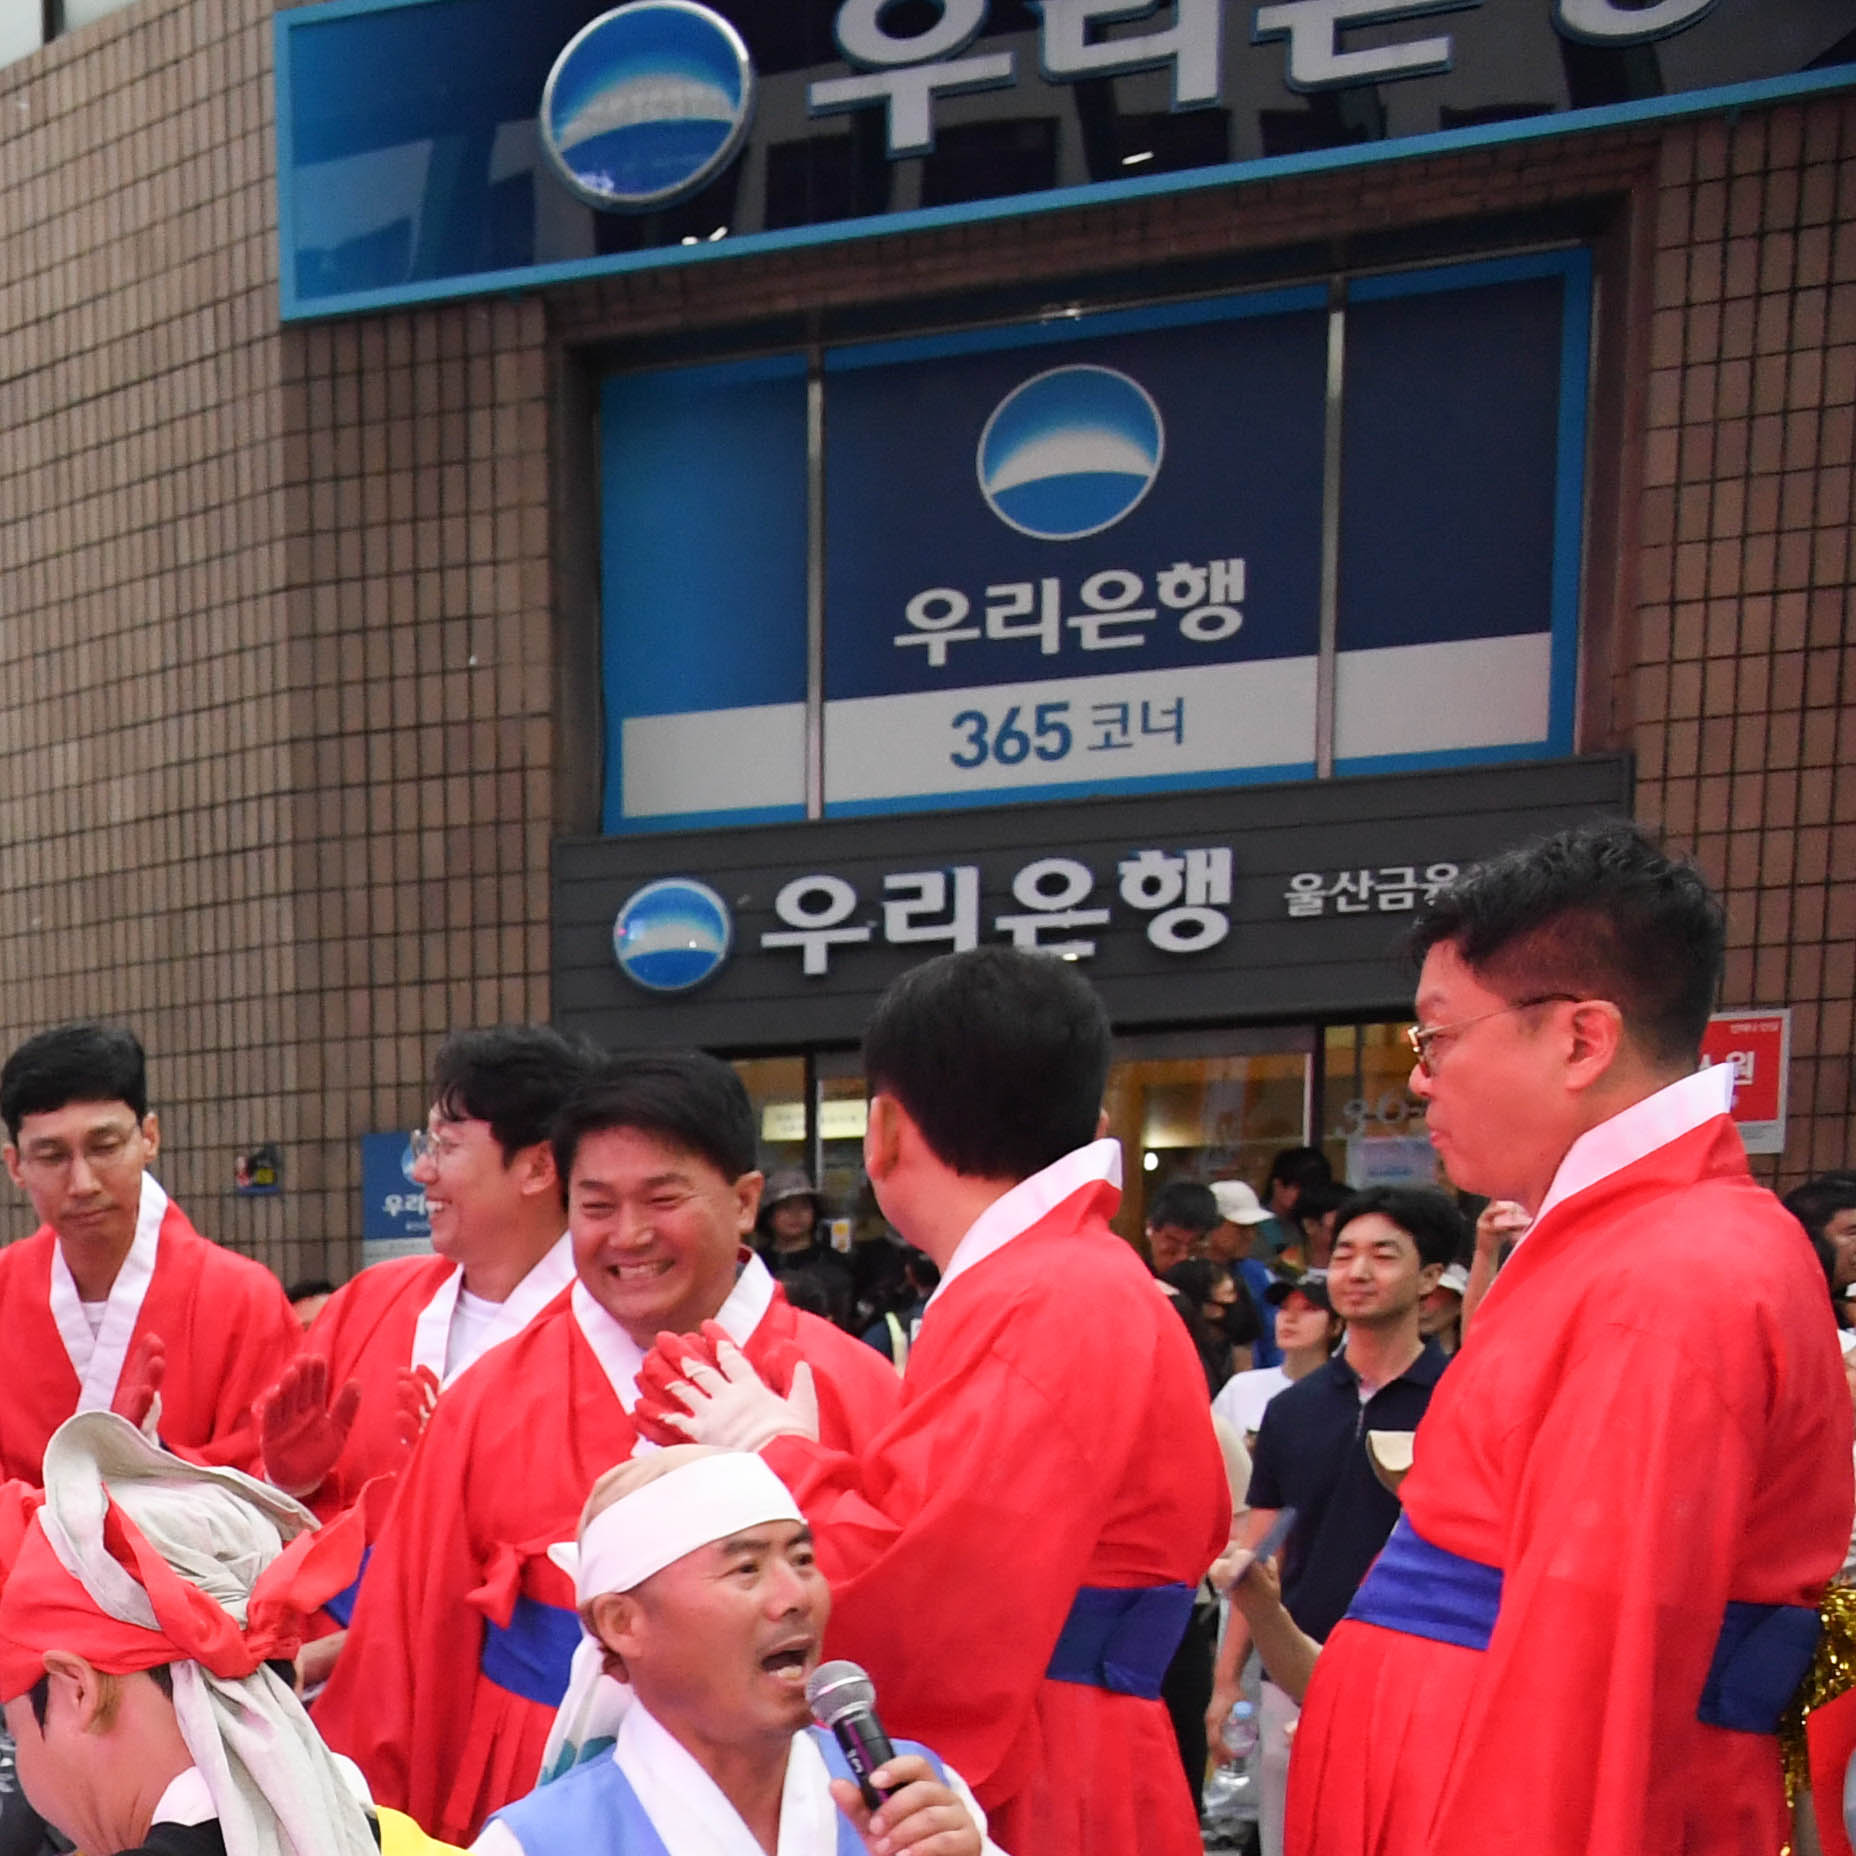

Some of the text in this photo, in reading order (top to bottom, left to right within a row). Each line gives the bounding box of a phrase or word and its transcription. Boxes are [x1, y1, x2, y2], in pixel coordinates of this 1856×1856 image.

[893, 557, 1246, 667] 우리은행
[949, 697, 1186, 769] 365 코너
[760, 845, 1233, 976] 우리은행
